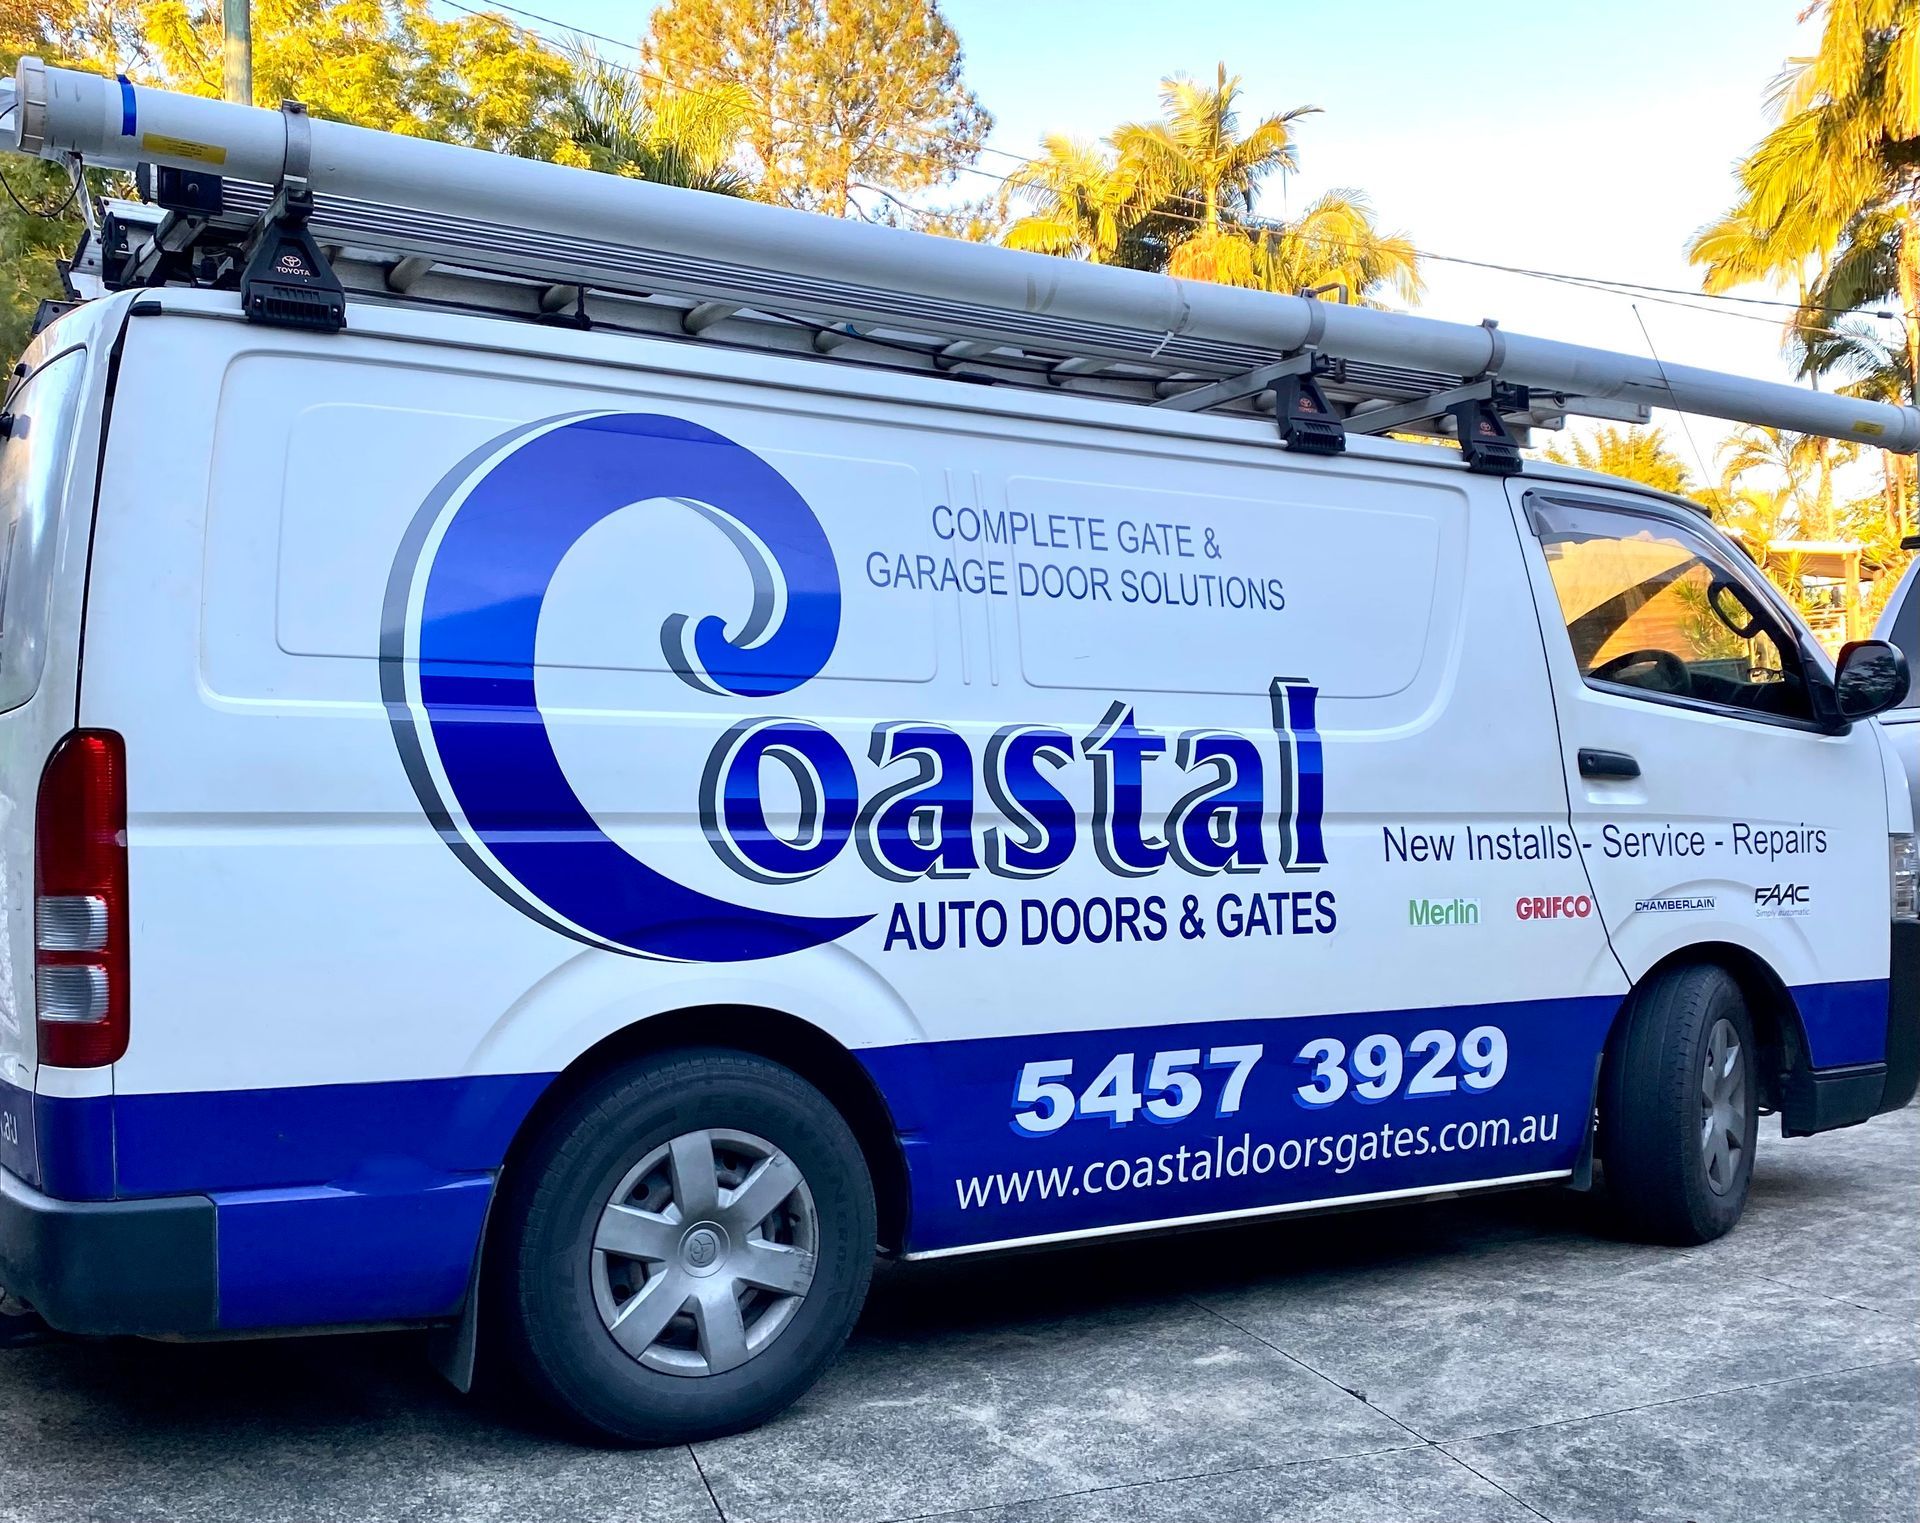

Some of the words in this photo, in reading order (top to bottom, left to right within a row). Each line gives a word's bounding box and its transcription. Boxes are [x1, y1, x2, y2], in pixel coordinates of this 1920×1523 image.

[276, 266, 311, 277] TOYOTA
[931, 504, 1109, 552] COMPLETE
[1117, 520, 1195, 558] GATE
[1203, 526, 1223, 560] &
[866, 551, 1009, 596] GARAGE
[1018, 562, 1113, 602] DOOR
[1120, 568, 1287, 612] SOLUTIONS
[379, 409, 1328, 963] Coastal
[1383, 826, 1455, 862] New
[1467, 824, 1572, 861] Installs
[1602, 823, 1705, 859] Service
[1732, 821, 1828, 862] Repairs
[1409, 898, 1479, 926] Merlin
[1516, 895, 1592, 921] GRIFCO
[1635, 898, 1716, 912] CHAMBERLAIN
[1754, 883, 1810, 907] FAAC
[883, 899, 1008, 952] AUTO
[1020, 896, 1168, 946] DOORS
[1179, 893, 1206, 941] &
[1216, 890, 1338, 938] GATES
[1010, 1044, 1264, 1137] 5457
[1293, 1025, 1508, 1109] 3929
[955, 1112, 1560, 1211] www.coastaldoorsgates.com.au
